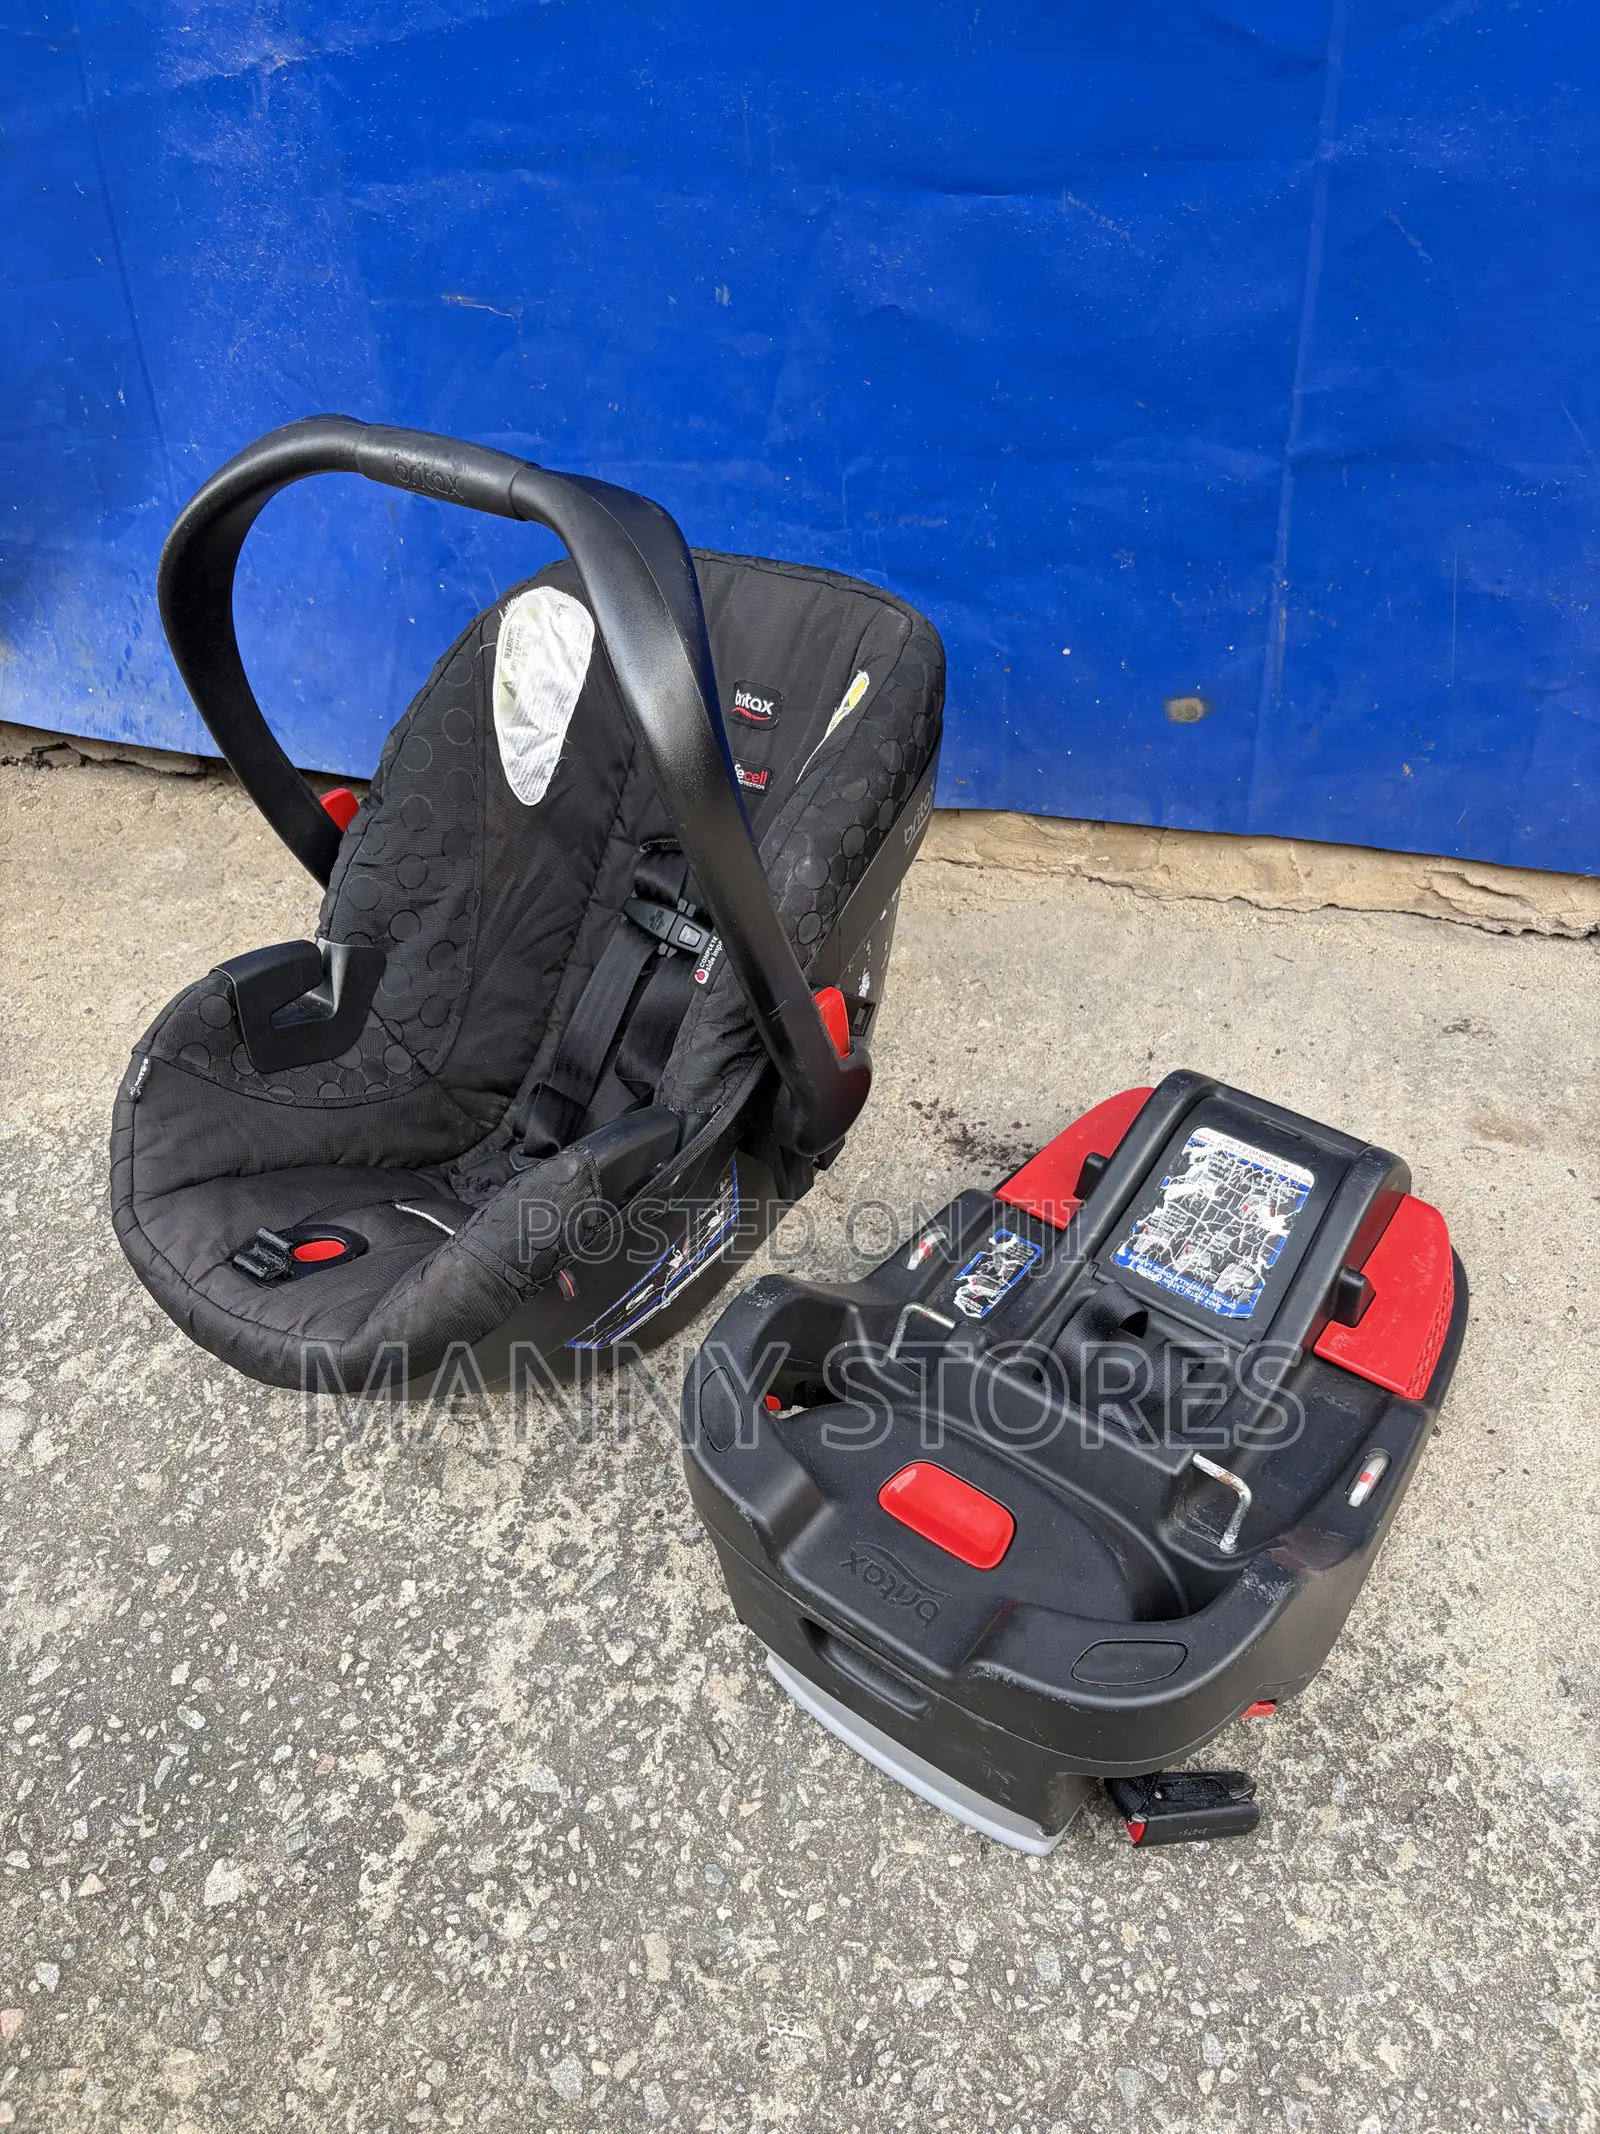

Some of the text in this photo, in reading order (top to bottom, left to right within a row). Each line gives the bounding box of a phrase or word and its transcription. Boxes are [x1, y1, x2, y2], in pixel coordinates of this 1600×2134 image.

[393, 454, 464, 499] britax
[735, 690, 775, 715] britax
[700, 936, 718, 968] COMPLETE
[839, 1547, 940, 1629] britax
